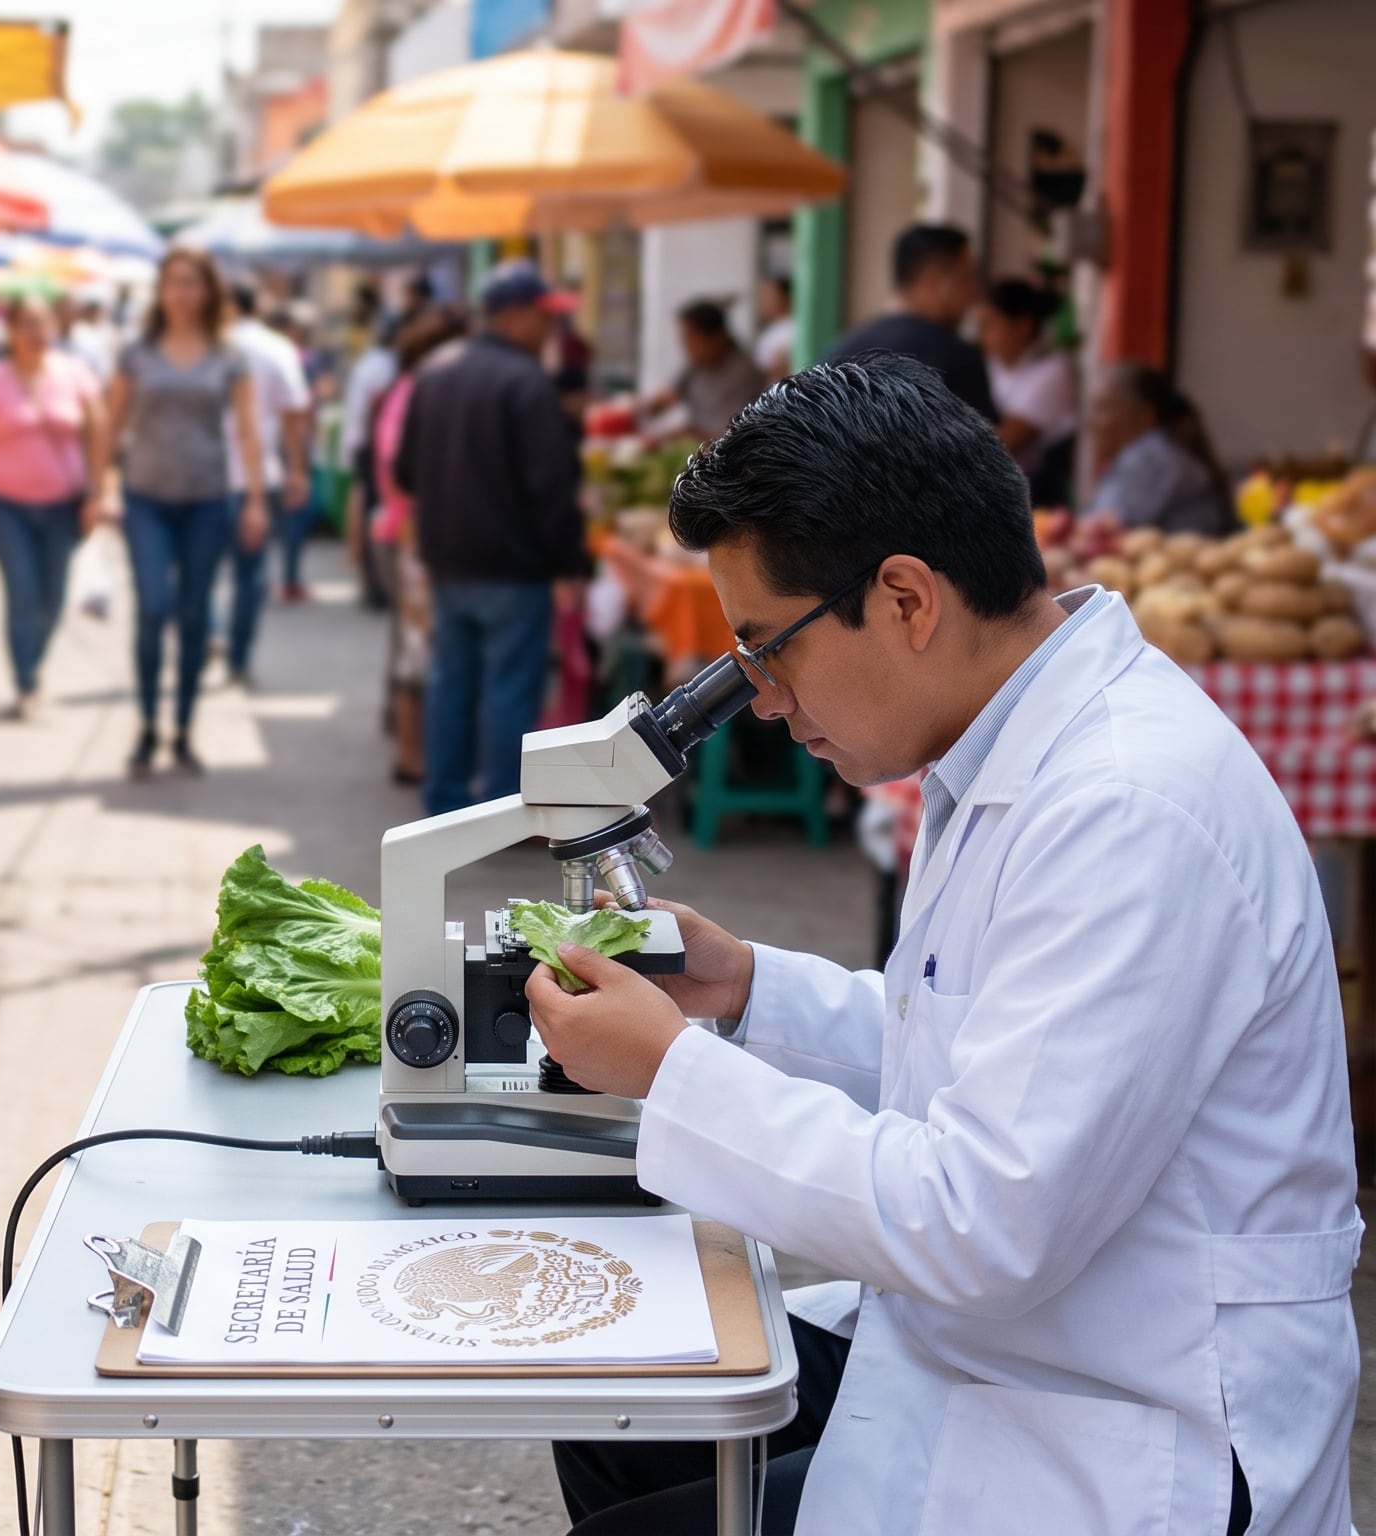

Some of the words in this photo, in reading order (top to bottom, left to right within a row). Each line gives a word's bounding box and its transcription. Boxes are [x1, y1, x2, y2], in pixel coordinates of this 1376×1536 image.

[224, 1236, 277, 1344] SECRETARÍA
[279, 1247, 317, 1304] SALUD
[274, 1308, 307, 1334] DE
